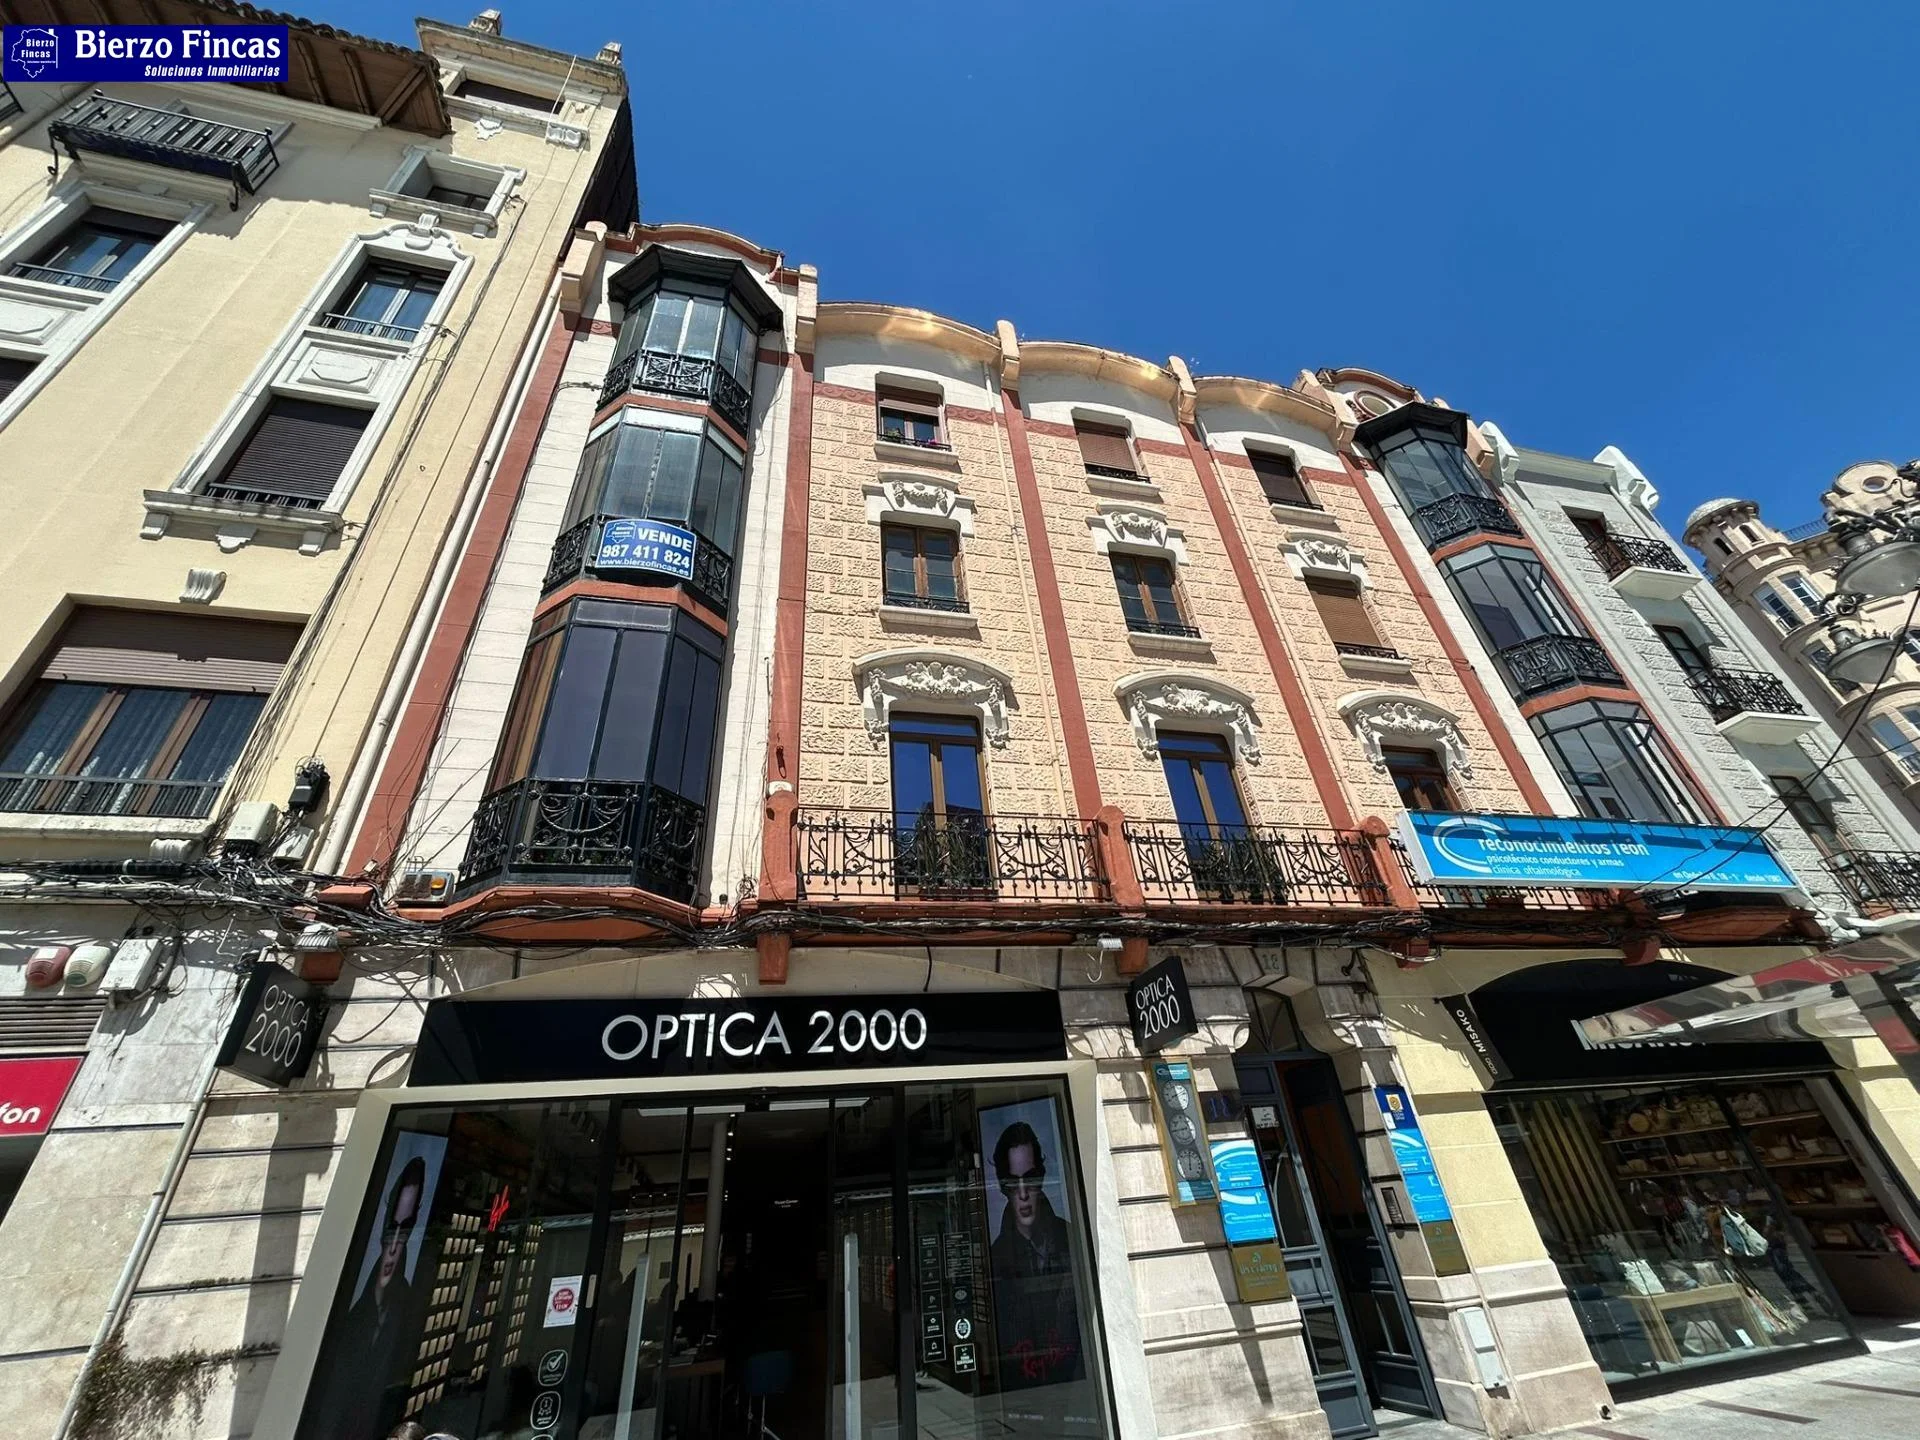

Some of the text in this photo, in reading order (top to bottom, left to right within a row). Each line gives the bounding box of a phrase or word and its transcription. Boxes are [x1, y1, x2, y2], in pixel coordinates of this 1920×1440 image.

[602, 545, 690, 568] 987 411 824
[638, 528, 692, 552] VENDE
[600, 558, 689, 577] www.bierzofincas.es
[1540, 855, 1590, 866] conductores
[1599, 859, 1625, 867] armas
[264, 984, 310, 1031] OPTICA
[1136, 974, 1175, 1010] OPTICA
[601, 1008, 927, 1061] OPTICA 2000
[1140, 994, 1180, 1039] 2000
[1456, 1009, 1487, 1053] MISAKO
[245, 1012, 302, 1068] 2000
